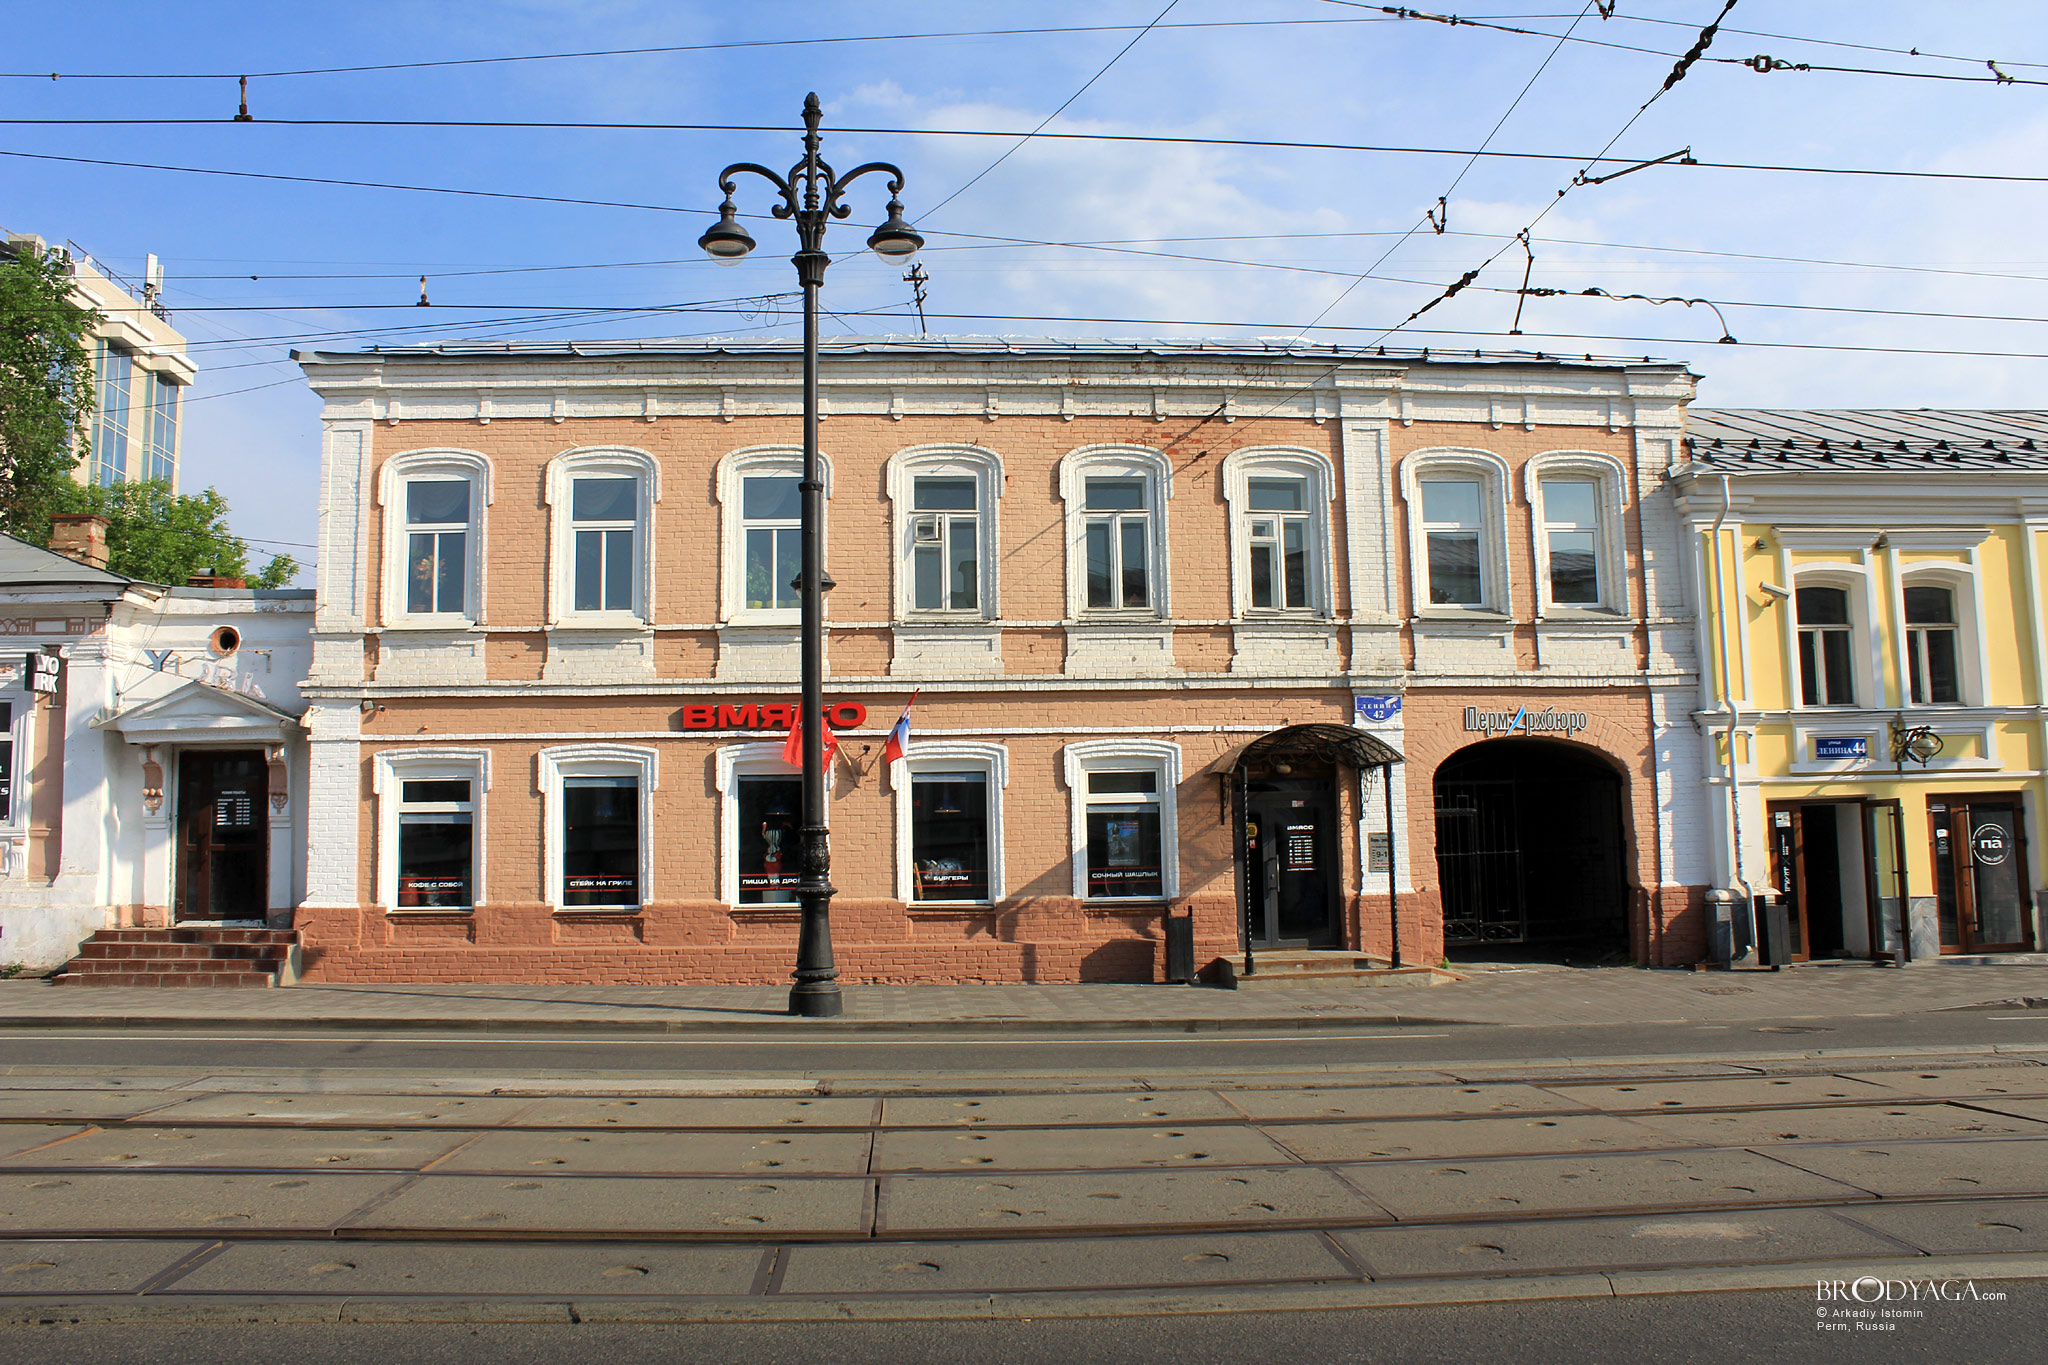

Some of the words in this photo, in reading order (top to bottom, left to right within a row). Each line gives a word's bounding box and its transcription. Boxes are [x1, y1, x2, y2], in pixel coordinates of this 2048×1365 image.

[682, 701, 867, 728] ВМЯО
[1373, 710, 1385, 719] 42
[1816, 747, 1853, 755] ЛЕНИНА
[1852, 742, 1867, 754] 44
[438, 880, 464, 888] СОБОЙ
[569, 879, 595, 887] СТЕЙК
